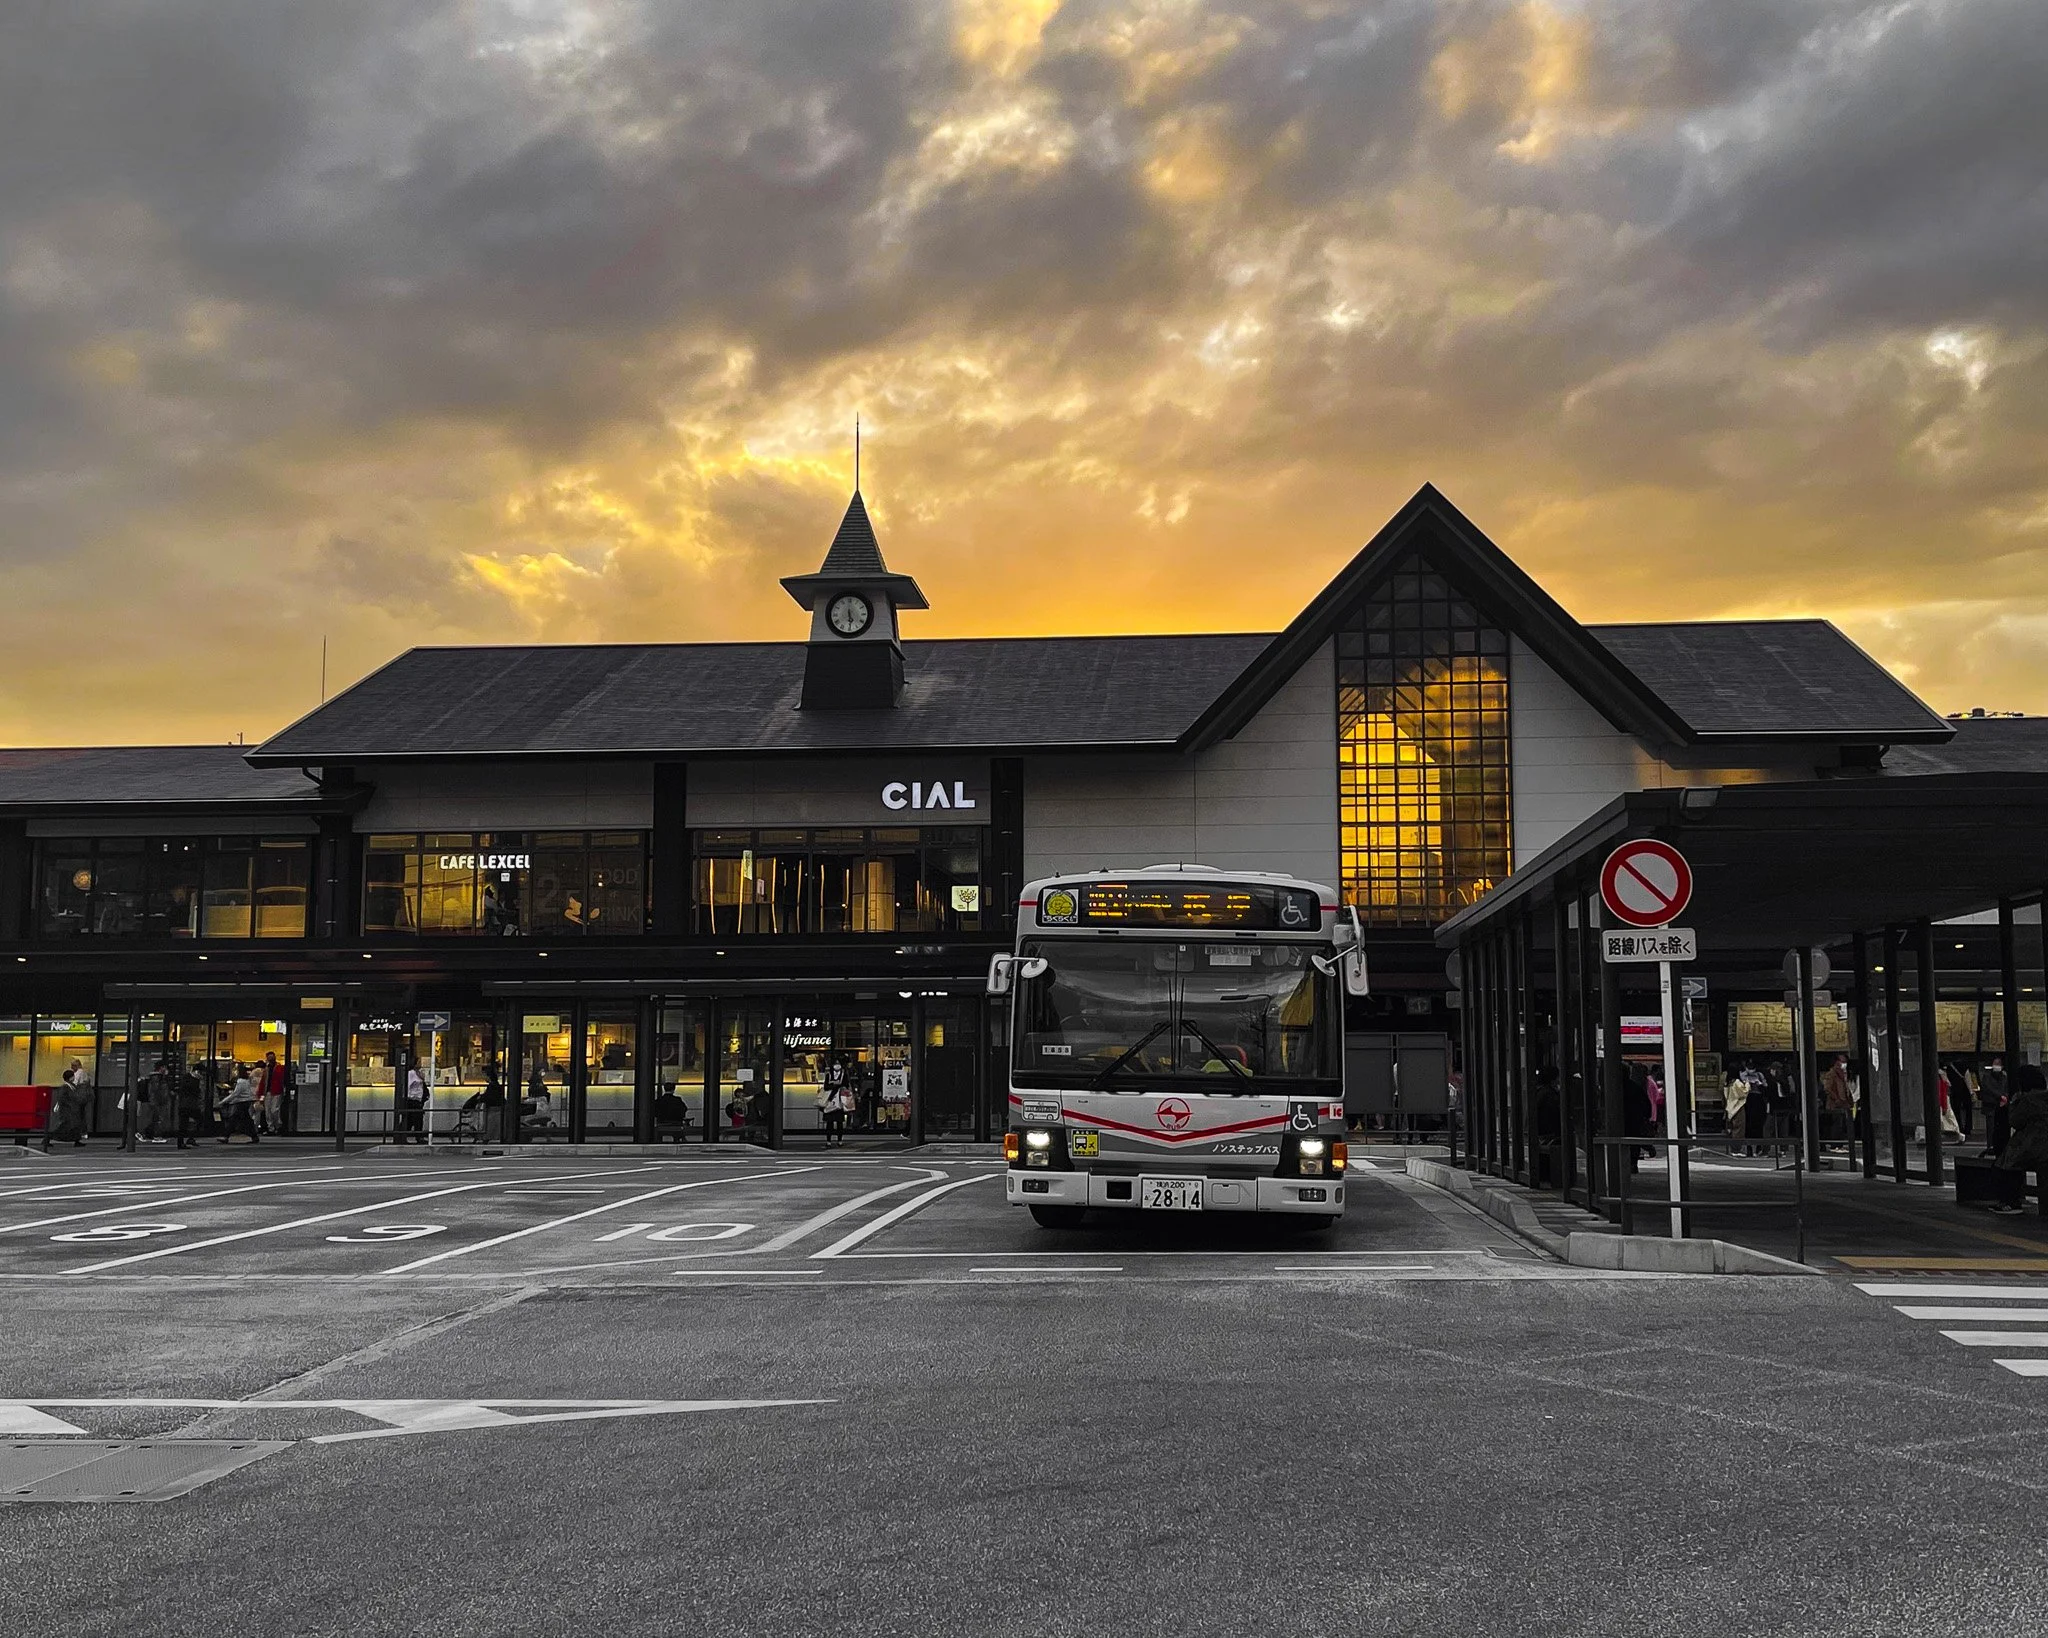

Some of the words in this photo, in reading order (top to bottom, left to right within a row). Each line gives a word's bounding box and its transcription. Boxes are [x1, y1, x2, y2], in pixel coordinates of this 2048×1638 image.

[882, 781, 975, 809] CIAL
[440, 855, 475, 869] CAFE
[480, 855, 530, 868] LEXCEL
[1608, 936, 1691, 955] 路線バスを除く
[783, 1033, 831, 1048] lifrance
[1212, 1144, 1280, 1154] ノンステップバス
[1152, 1189, 1200, 1208] 28-14
[50, 1223, 188, 1241] 8
[325, 1224, 447, 1242] 9
[592, 1223, 756, 1241] 10
